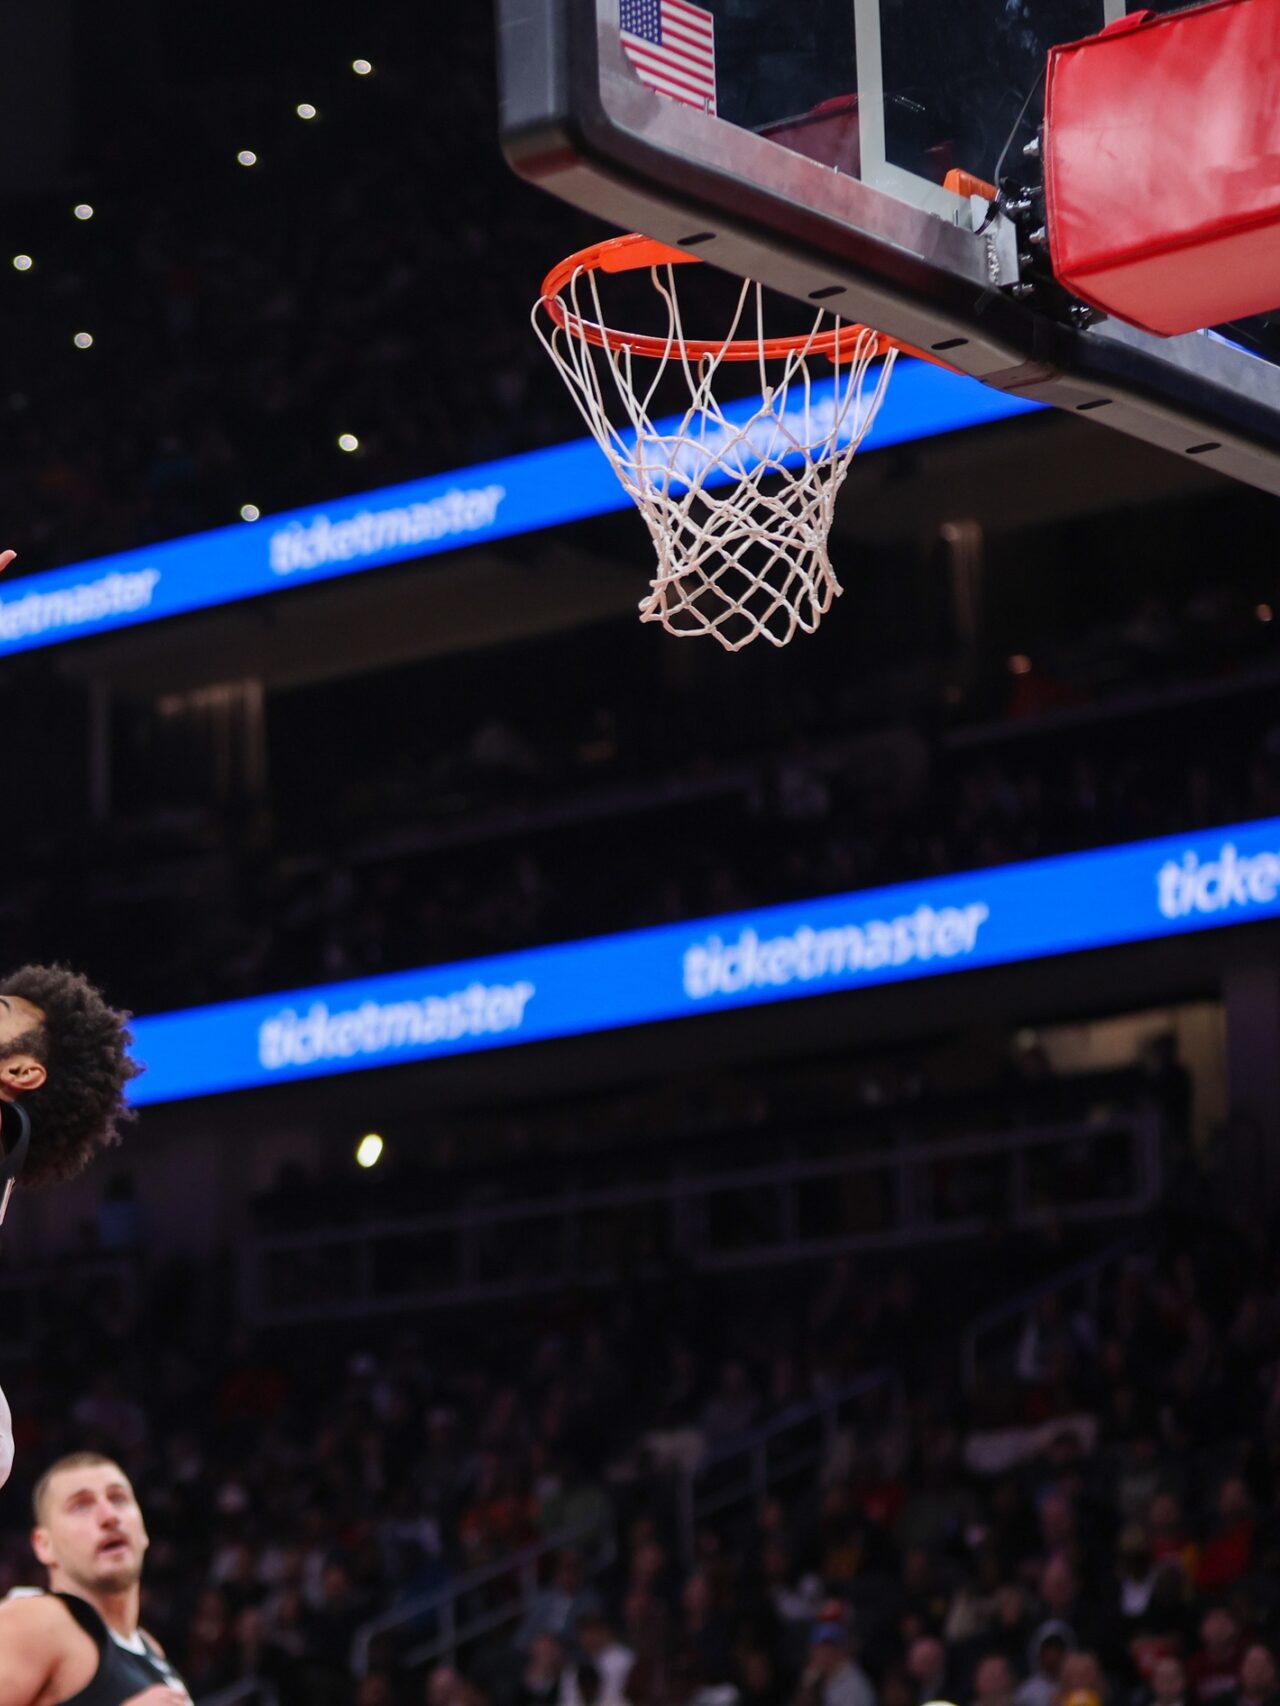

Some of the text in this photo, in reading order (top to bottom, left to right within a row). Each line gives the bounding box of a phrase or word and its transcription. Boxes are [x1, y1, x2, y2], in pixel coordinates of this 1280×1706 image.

[268, 485, 504, 573] ticketmaster
[259, 982, 534, 1067] ticketmaster
[684, 904, 989, 997] ticketmaster
[1158, 842, 1280, 917] ticke
